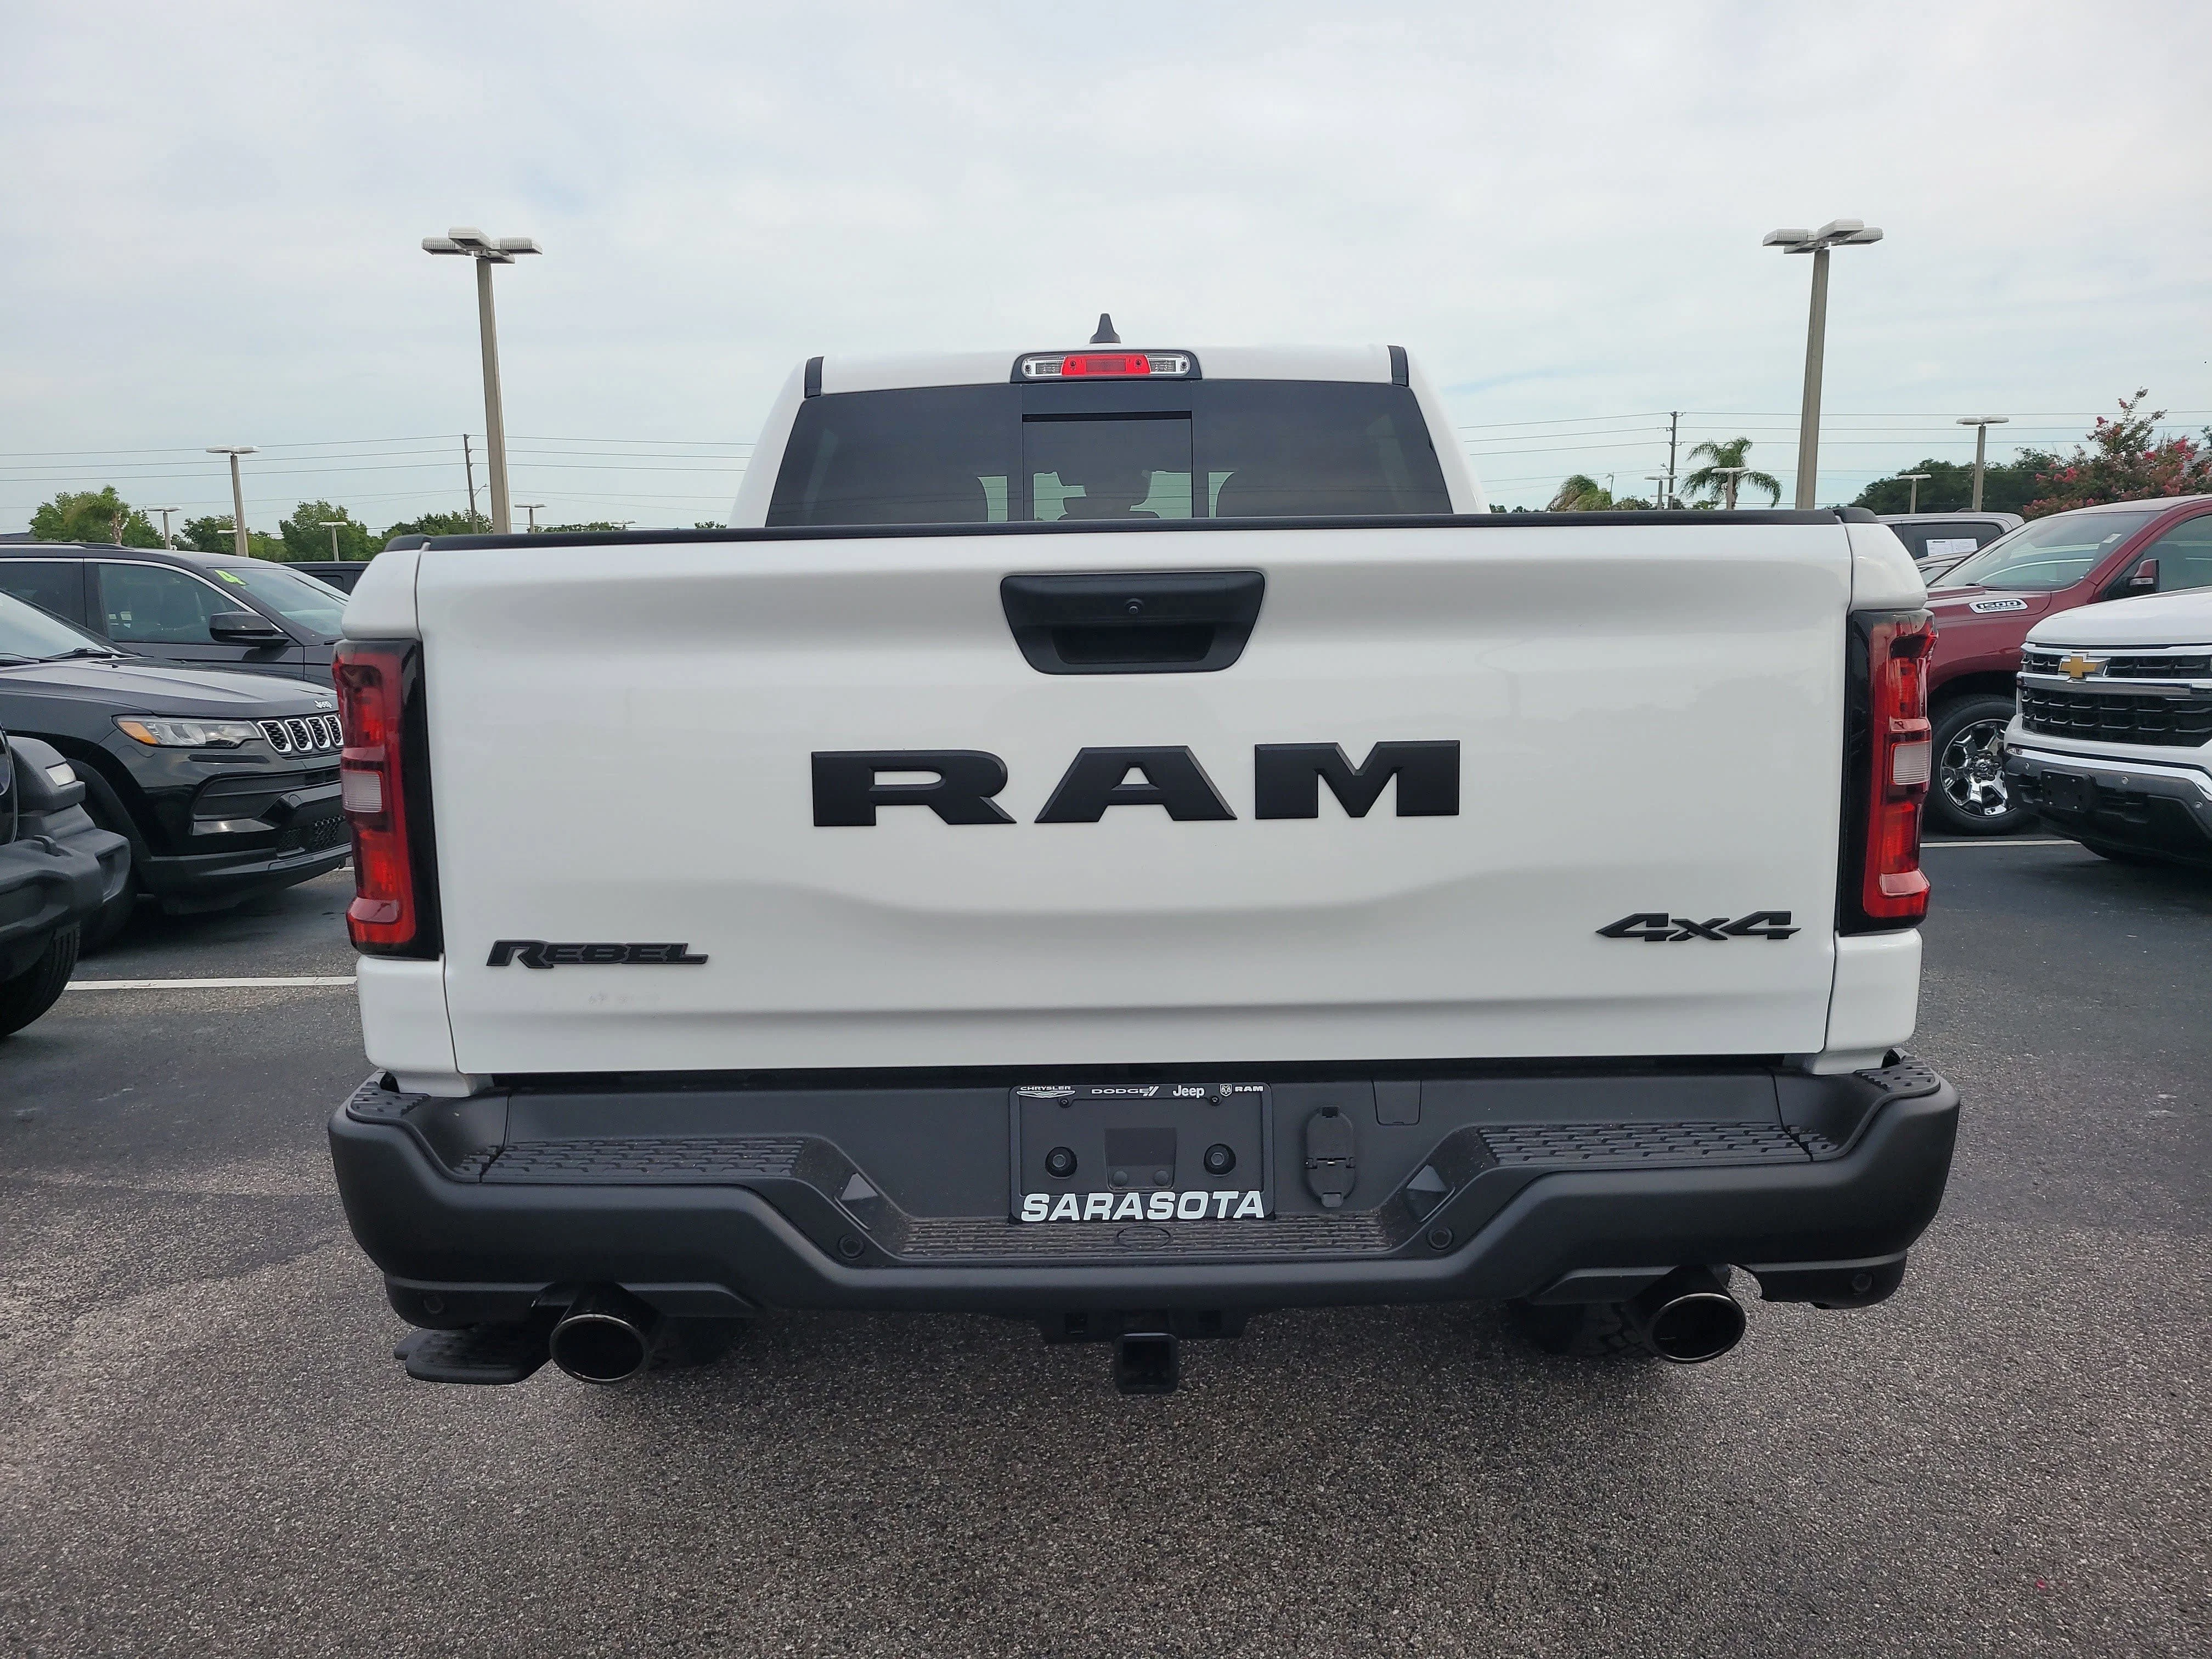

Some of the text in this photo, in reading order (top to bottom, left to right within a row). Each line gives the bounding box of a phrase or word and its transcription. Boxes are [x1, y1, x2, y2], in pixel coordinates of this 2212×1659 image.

[1978, 600, 2018, 609] 1500
[313, 699, 332, 709] Jeep
[811, 739, 1460, 827] RAM
[486, 939, 709, 969] REBEL
[1172, 1085, 1205, 1098] Jeep
[1020, 1190, 1265, 1222] SARASOTA
